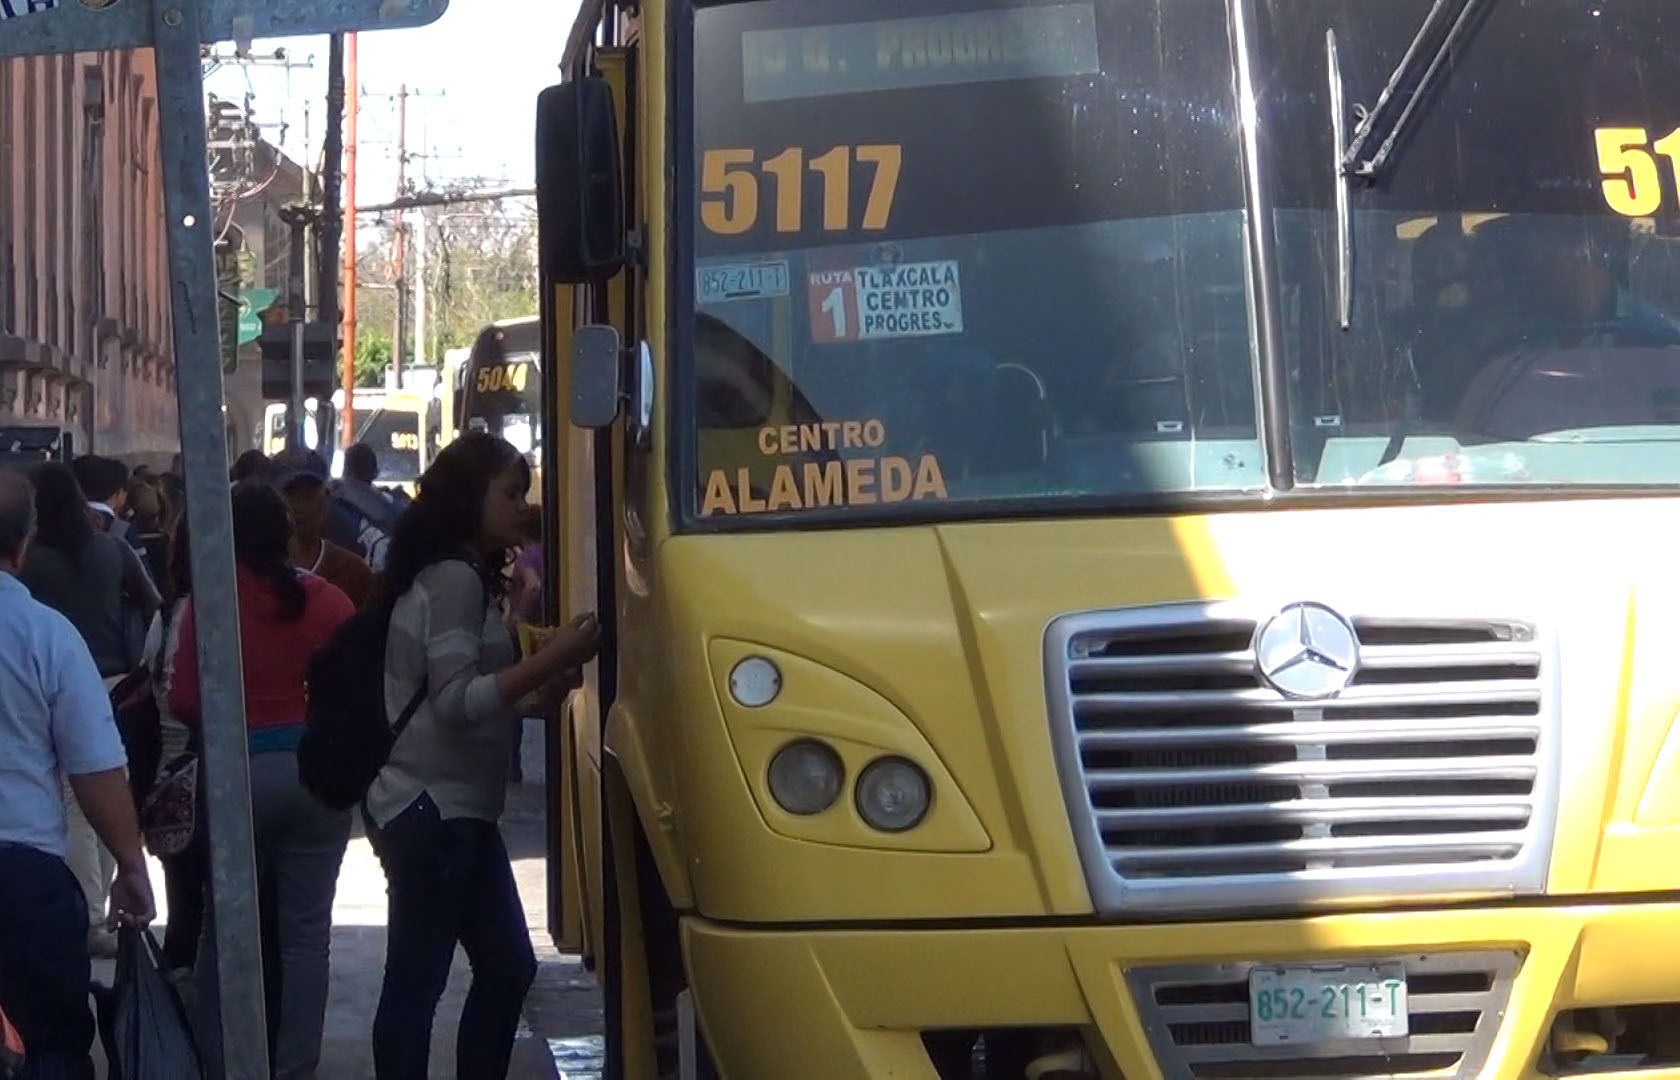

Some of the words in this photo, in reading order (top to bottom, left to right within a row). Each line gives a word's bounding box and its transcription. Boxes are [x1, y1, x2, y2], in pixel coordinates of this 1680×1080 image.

[701, 144, 902, 234] 5117
[701, 266, 782, 292] 852-211-T
[810, 271, 854, 285] RUTA
[858, 265, 957, 289] TLAXCALA
[821, 287, 847, 338] 1
[866, 287, 950, 311] CENTRO
[758, 418, 885, 455] CENTRO
[700, 453, 948, 516] ALAMEDA
[1257, 979, 1401, 1021] 852-211-T
